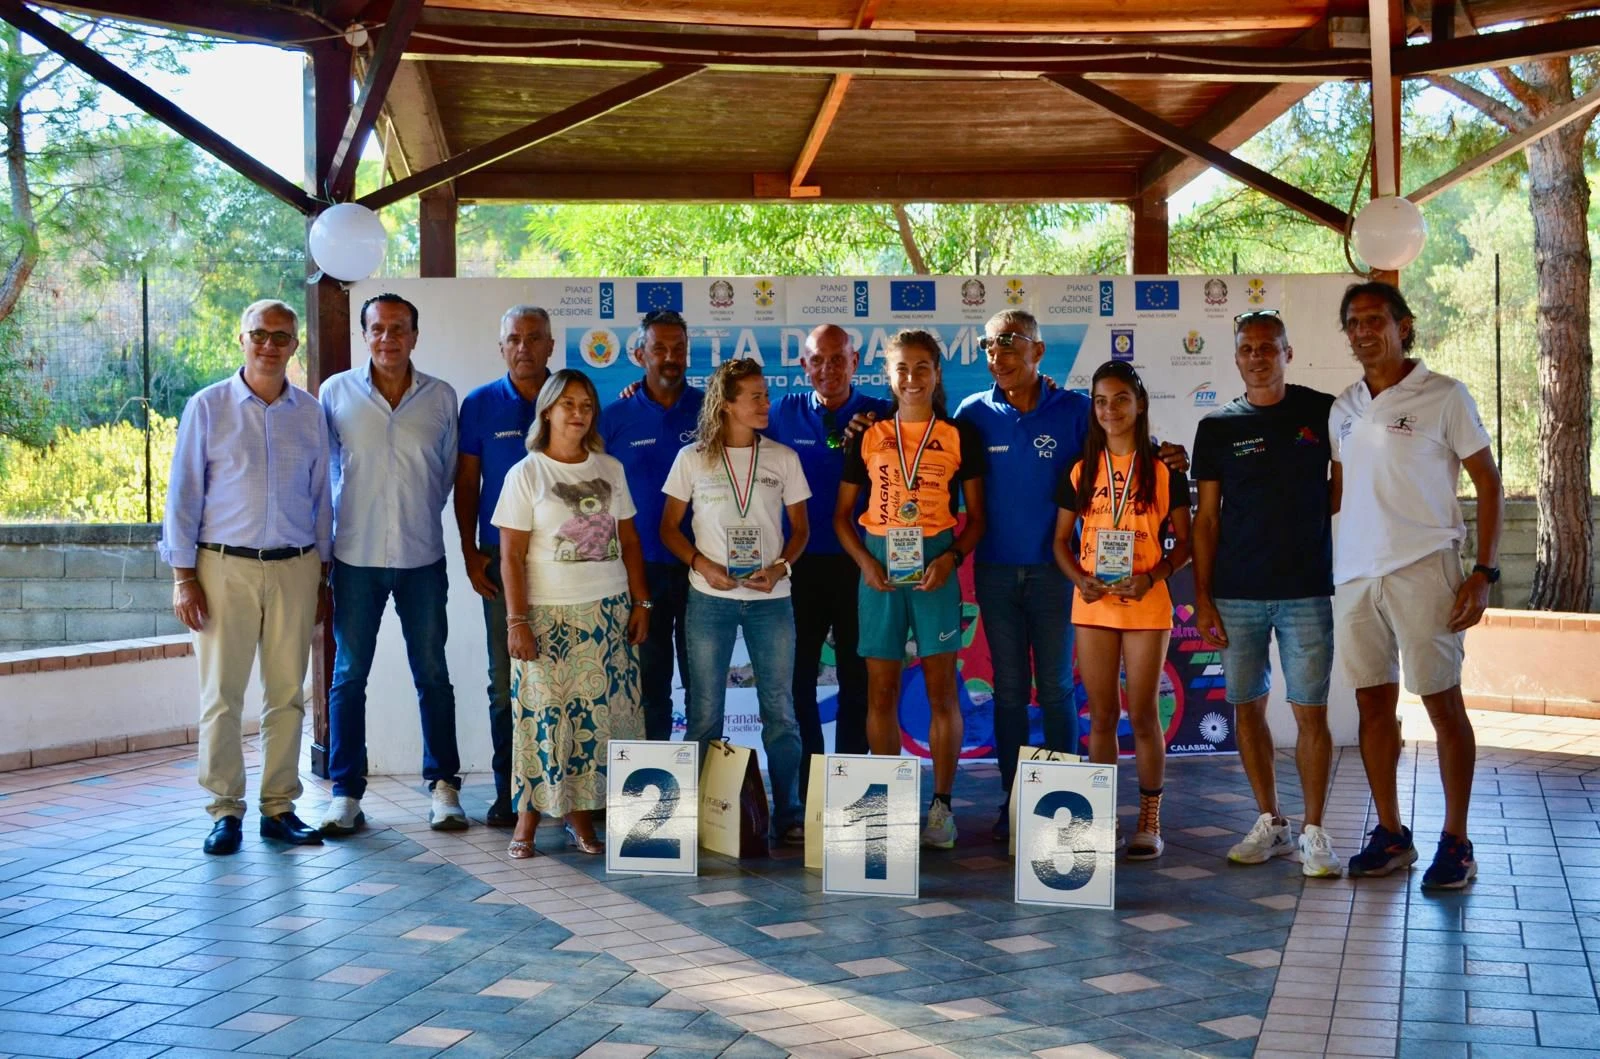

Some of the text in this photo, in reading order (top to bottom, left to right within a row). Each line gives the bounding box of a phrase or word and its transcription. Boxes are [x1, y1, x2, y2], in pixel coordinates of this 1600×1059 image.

[565, 286, 593, 294] PIANO
[820, 284, 848, 292] PIANO
[1066, 284, 1094, 292] PIANO
[560, 297, 593, 305] AZIONE
[601, 288, 613, 314] PAC
[815, 295, 848, 303] AZIONE
[855, 286, 868, 312] PAC
[1062, 295, 1094, 303] AZIONE
[1101, 286, 1113, 312] PAC
[802, 306, 849, 314] COESIONE
[1048, 305, 1094, 314] COESIONE
[1195, 391, 1217, 400] FITRI
[1038, 450, 1053, 459] FCI
[1170, 744, 1217, 752] CALABRIA
[619, 767, 681, 859] 2
[843, 783, 888, 880] 1
[1031, 790, 1097, 891] 3
